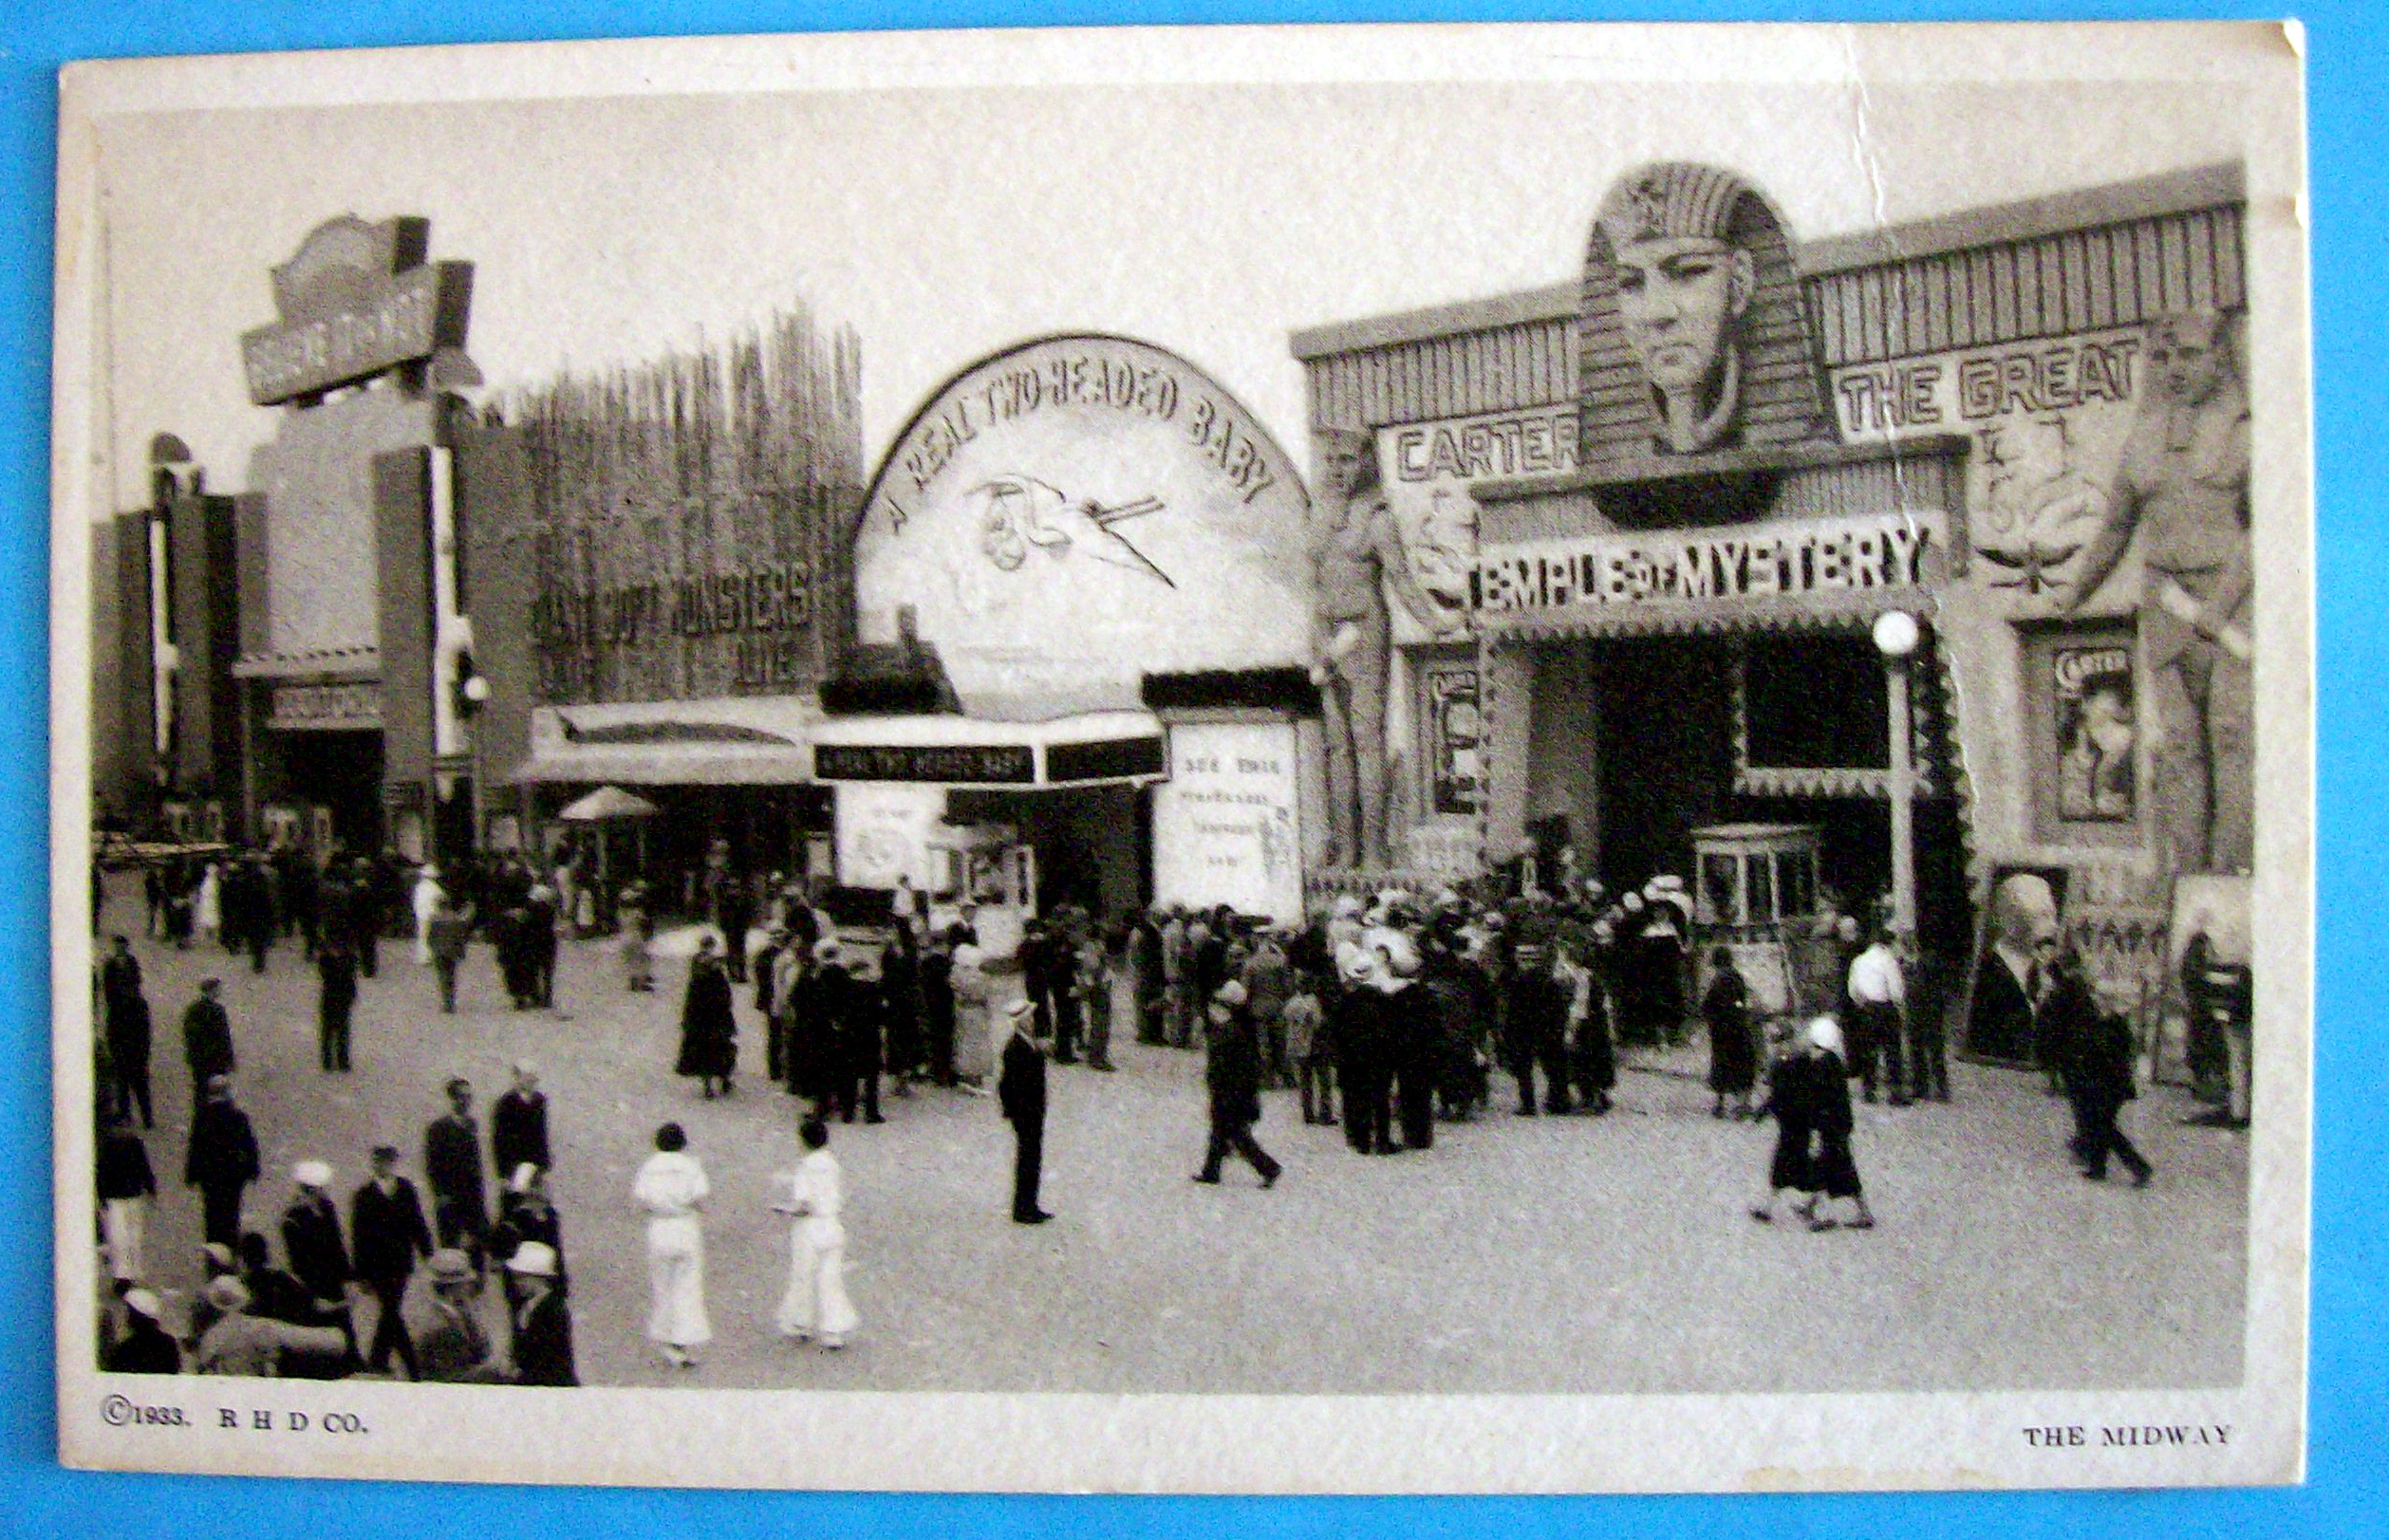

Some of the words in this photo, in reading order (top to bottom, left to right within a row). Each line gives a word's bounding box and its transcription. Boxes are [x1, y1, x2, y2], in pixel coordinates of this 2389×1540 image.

[904, 396, 978, 492] REAL
[1049, 354, 1180, 423] HEADED
[1188, 395, 1276, 505] BABY
[1397, 412, 1581, 484] CARTER
[1838, 364, 1946, 433] THE
[1959, 337, 2140, 420] GREAT
[1678, 525, 1924, 601] MYSTERY
[219, 1408, 239, 1429] R
[252, 1410, 272, 1431] H
[289, 1411, 309, 1431] D
[323, 1412, 370, 1434] CO.
[2023, 1426, 2085, 1447] THE
[2100, 1424, 2232, 1447] MIDWAY
